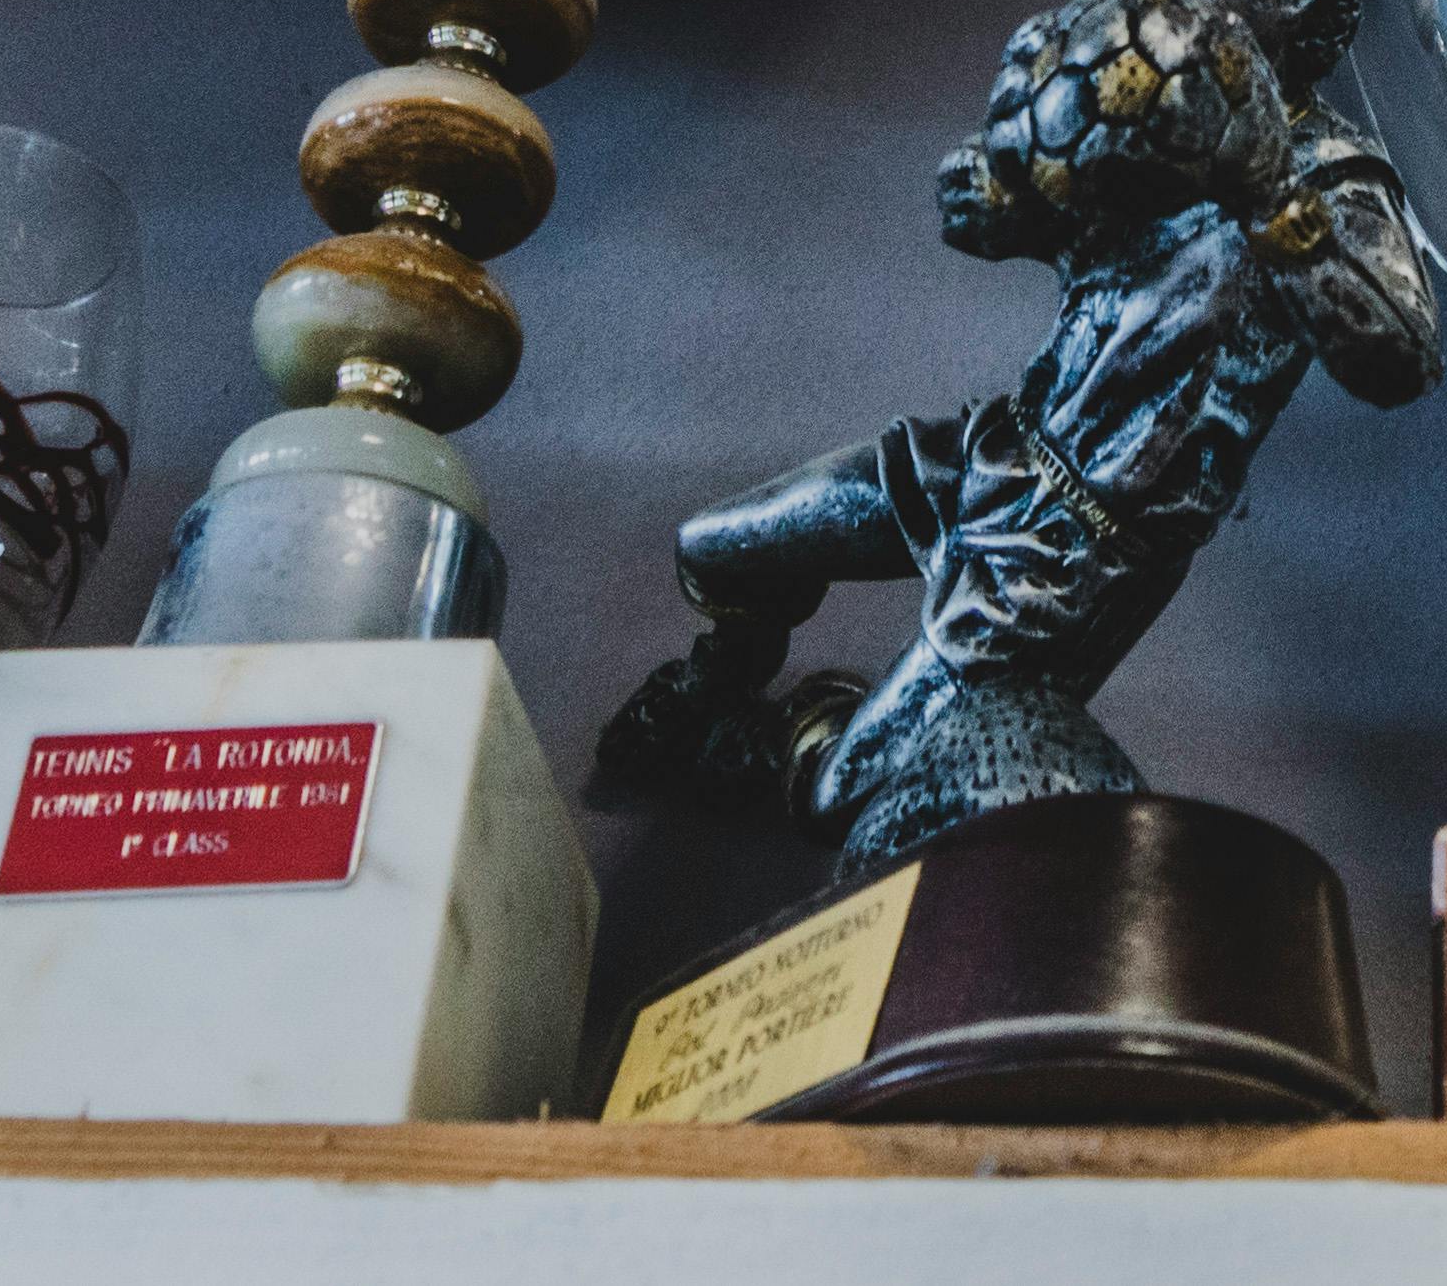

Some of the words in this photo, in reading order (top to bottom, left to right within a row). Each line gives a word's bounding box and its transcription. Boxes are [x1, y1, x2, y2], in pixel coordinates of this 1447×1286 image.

[33, 746, 134, 777] TENNIS
[30, 792, 123, 820] TORNEO
[132, 783, 286, 815] PRIMAVERILE
[153, 830, 230, 858] CLASS
